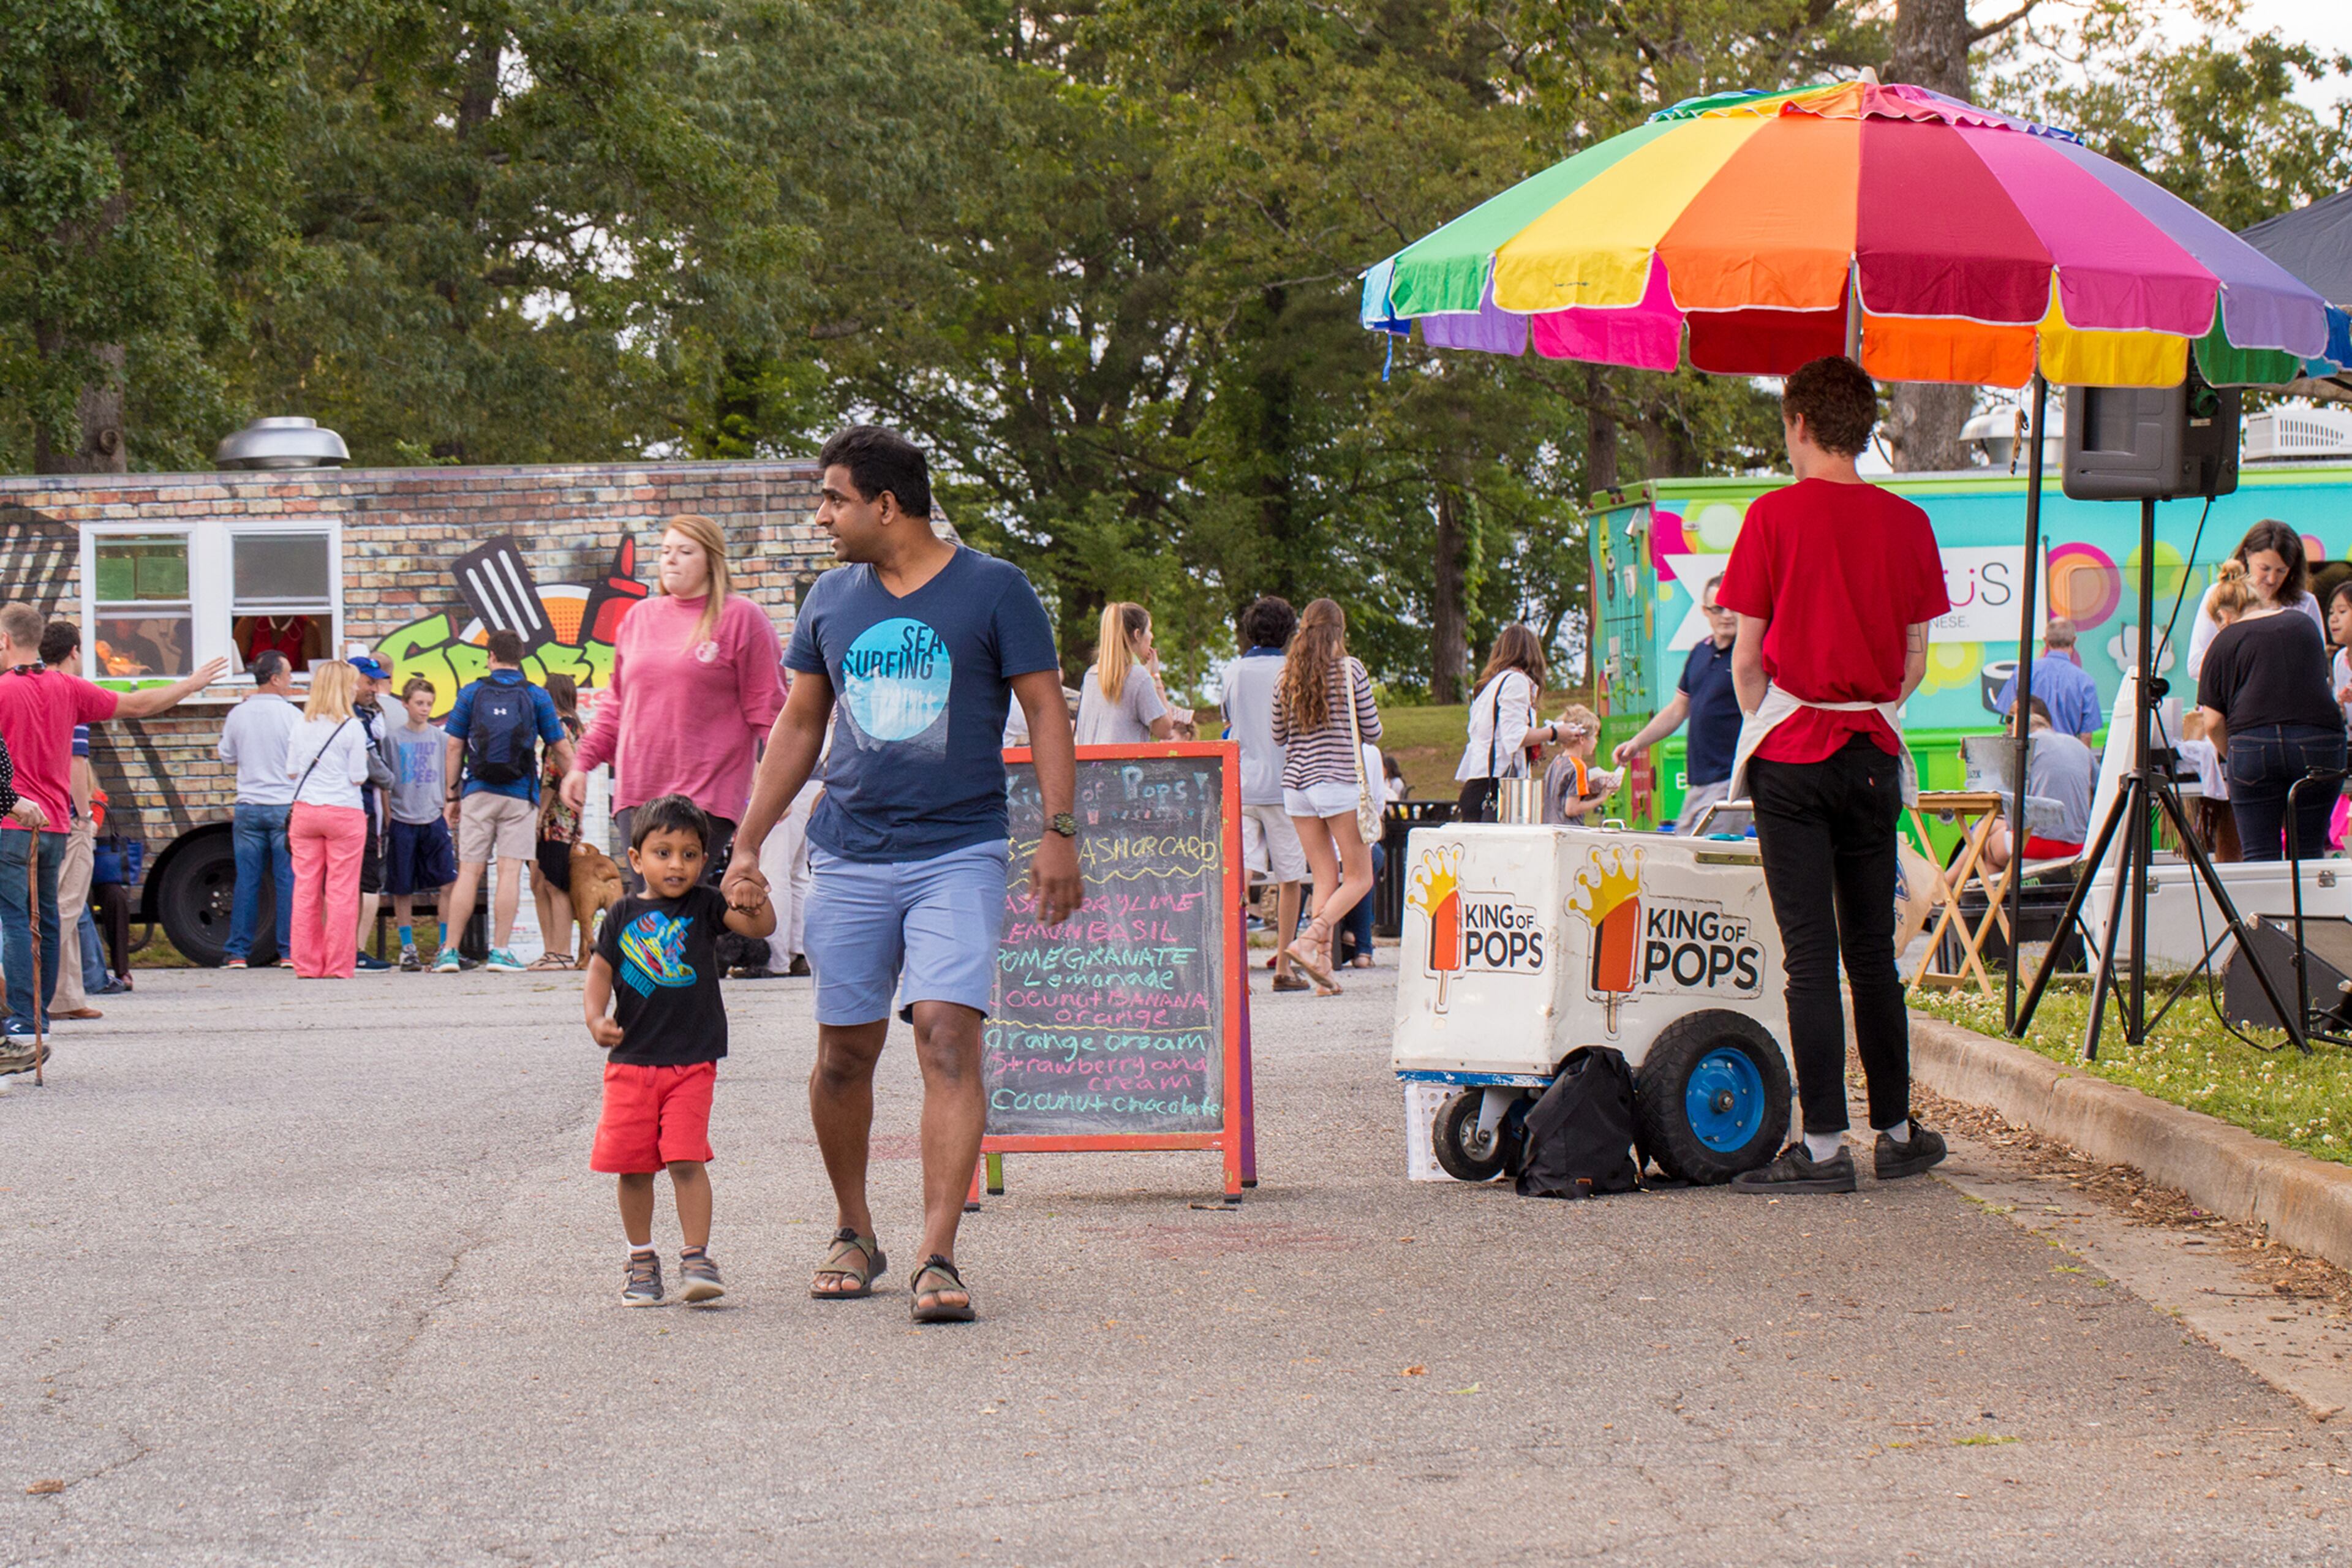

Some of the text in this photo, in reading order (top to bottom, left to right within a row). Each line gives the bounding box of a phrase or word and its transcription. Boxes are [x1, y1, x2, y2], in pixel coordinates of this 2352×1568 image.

[900, 625, 943, 654] SEA
[841, 649, 935, 680] SURFING
[1087, 919, 1180, 942] BASIL
[1464, 903, 1534, 929] KING OF
[1646, 908, 1747, 943] KING OF
[1464, 931, 1544, 969] POPS
[1643, 940, 1759, 989] POPS
